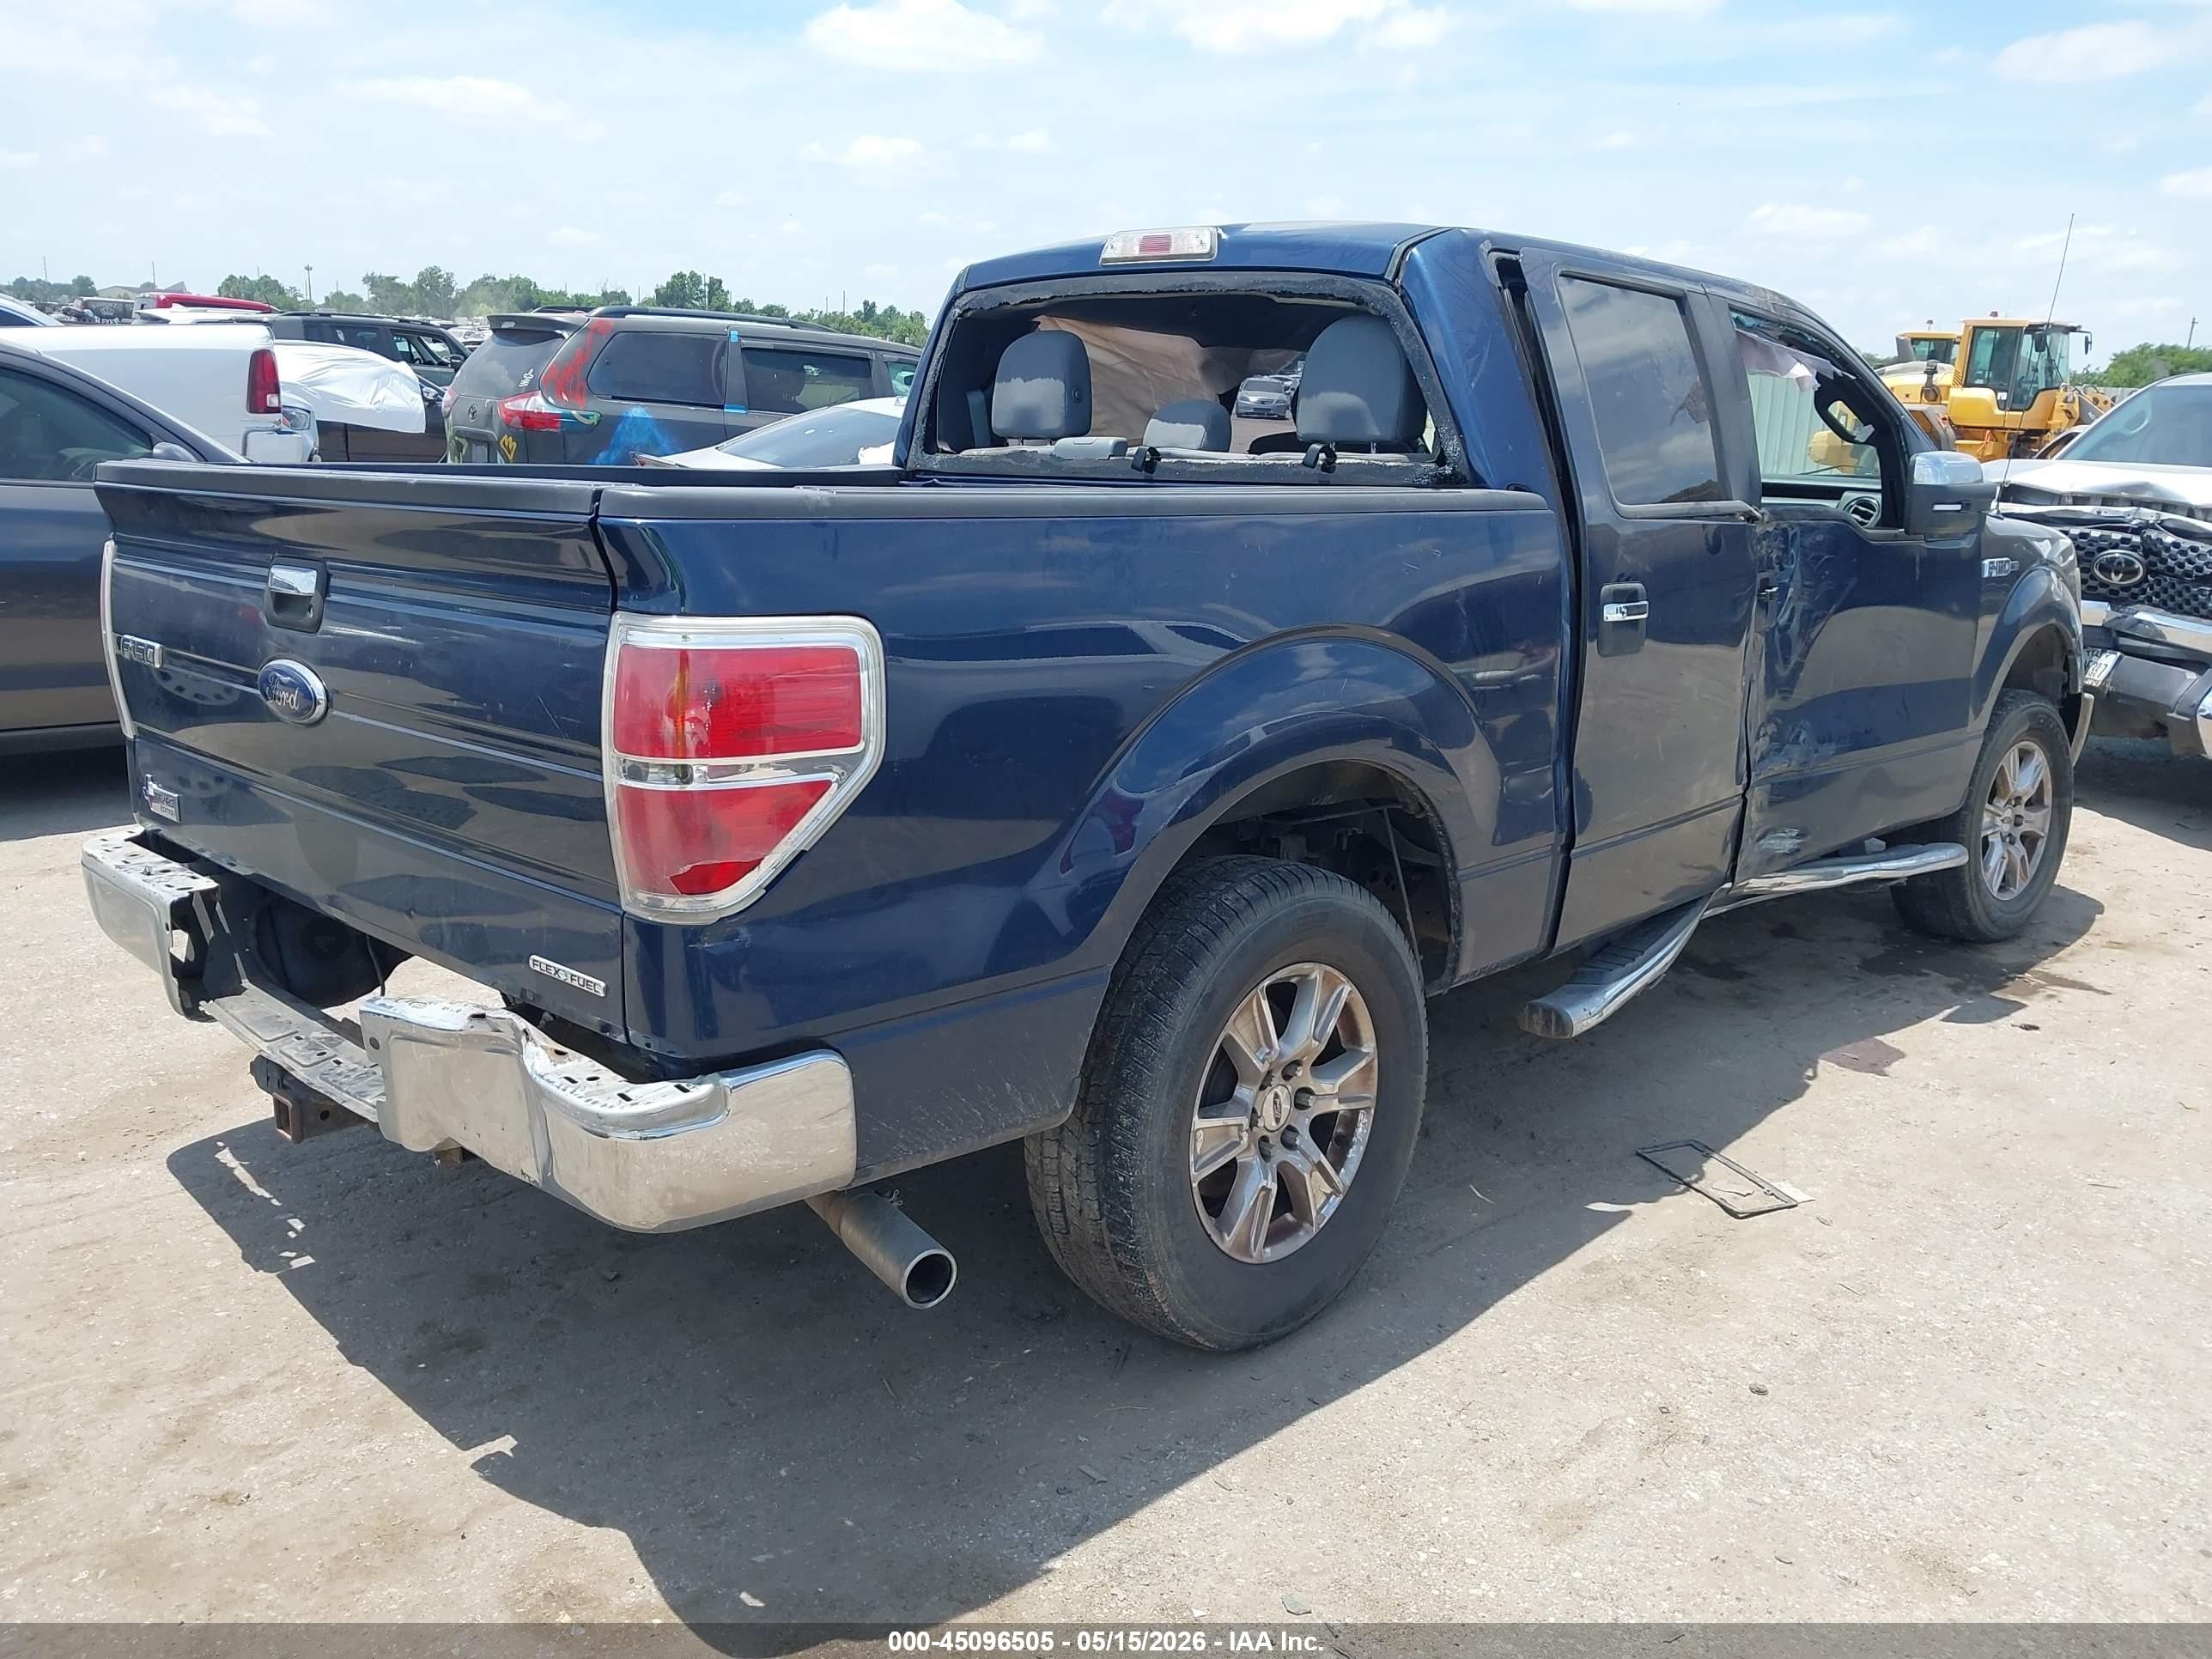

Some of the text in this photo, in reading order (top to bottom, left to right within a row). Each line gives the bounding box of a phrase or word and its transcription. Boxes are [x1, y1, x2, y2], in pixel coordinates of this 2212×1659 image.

[266, 672, 301, 710] Ford
[532, 958, 602, 994] FLEX FUEL
